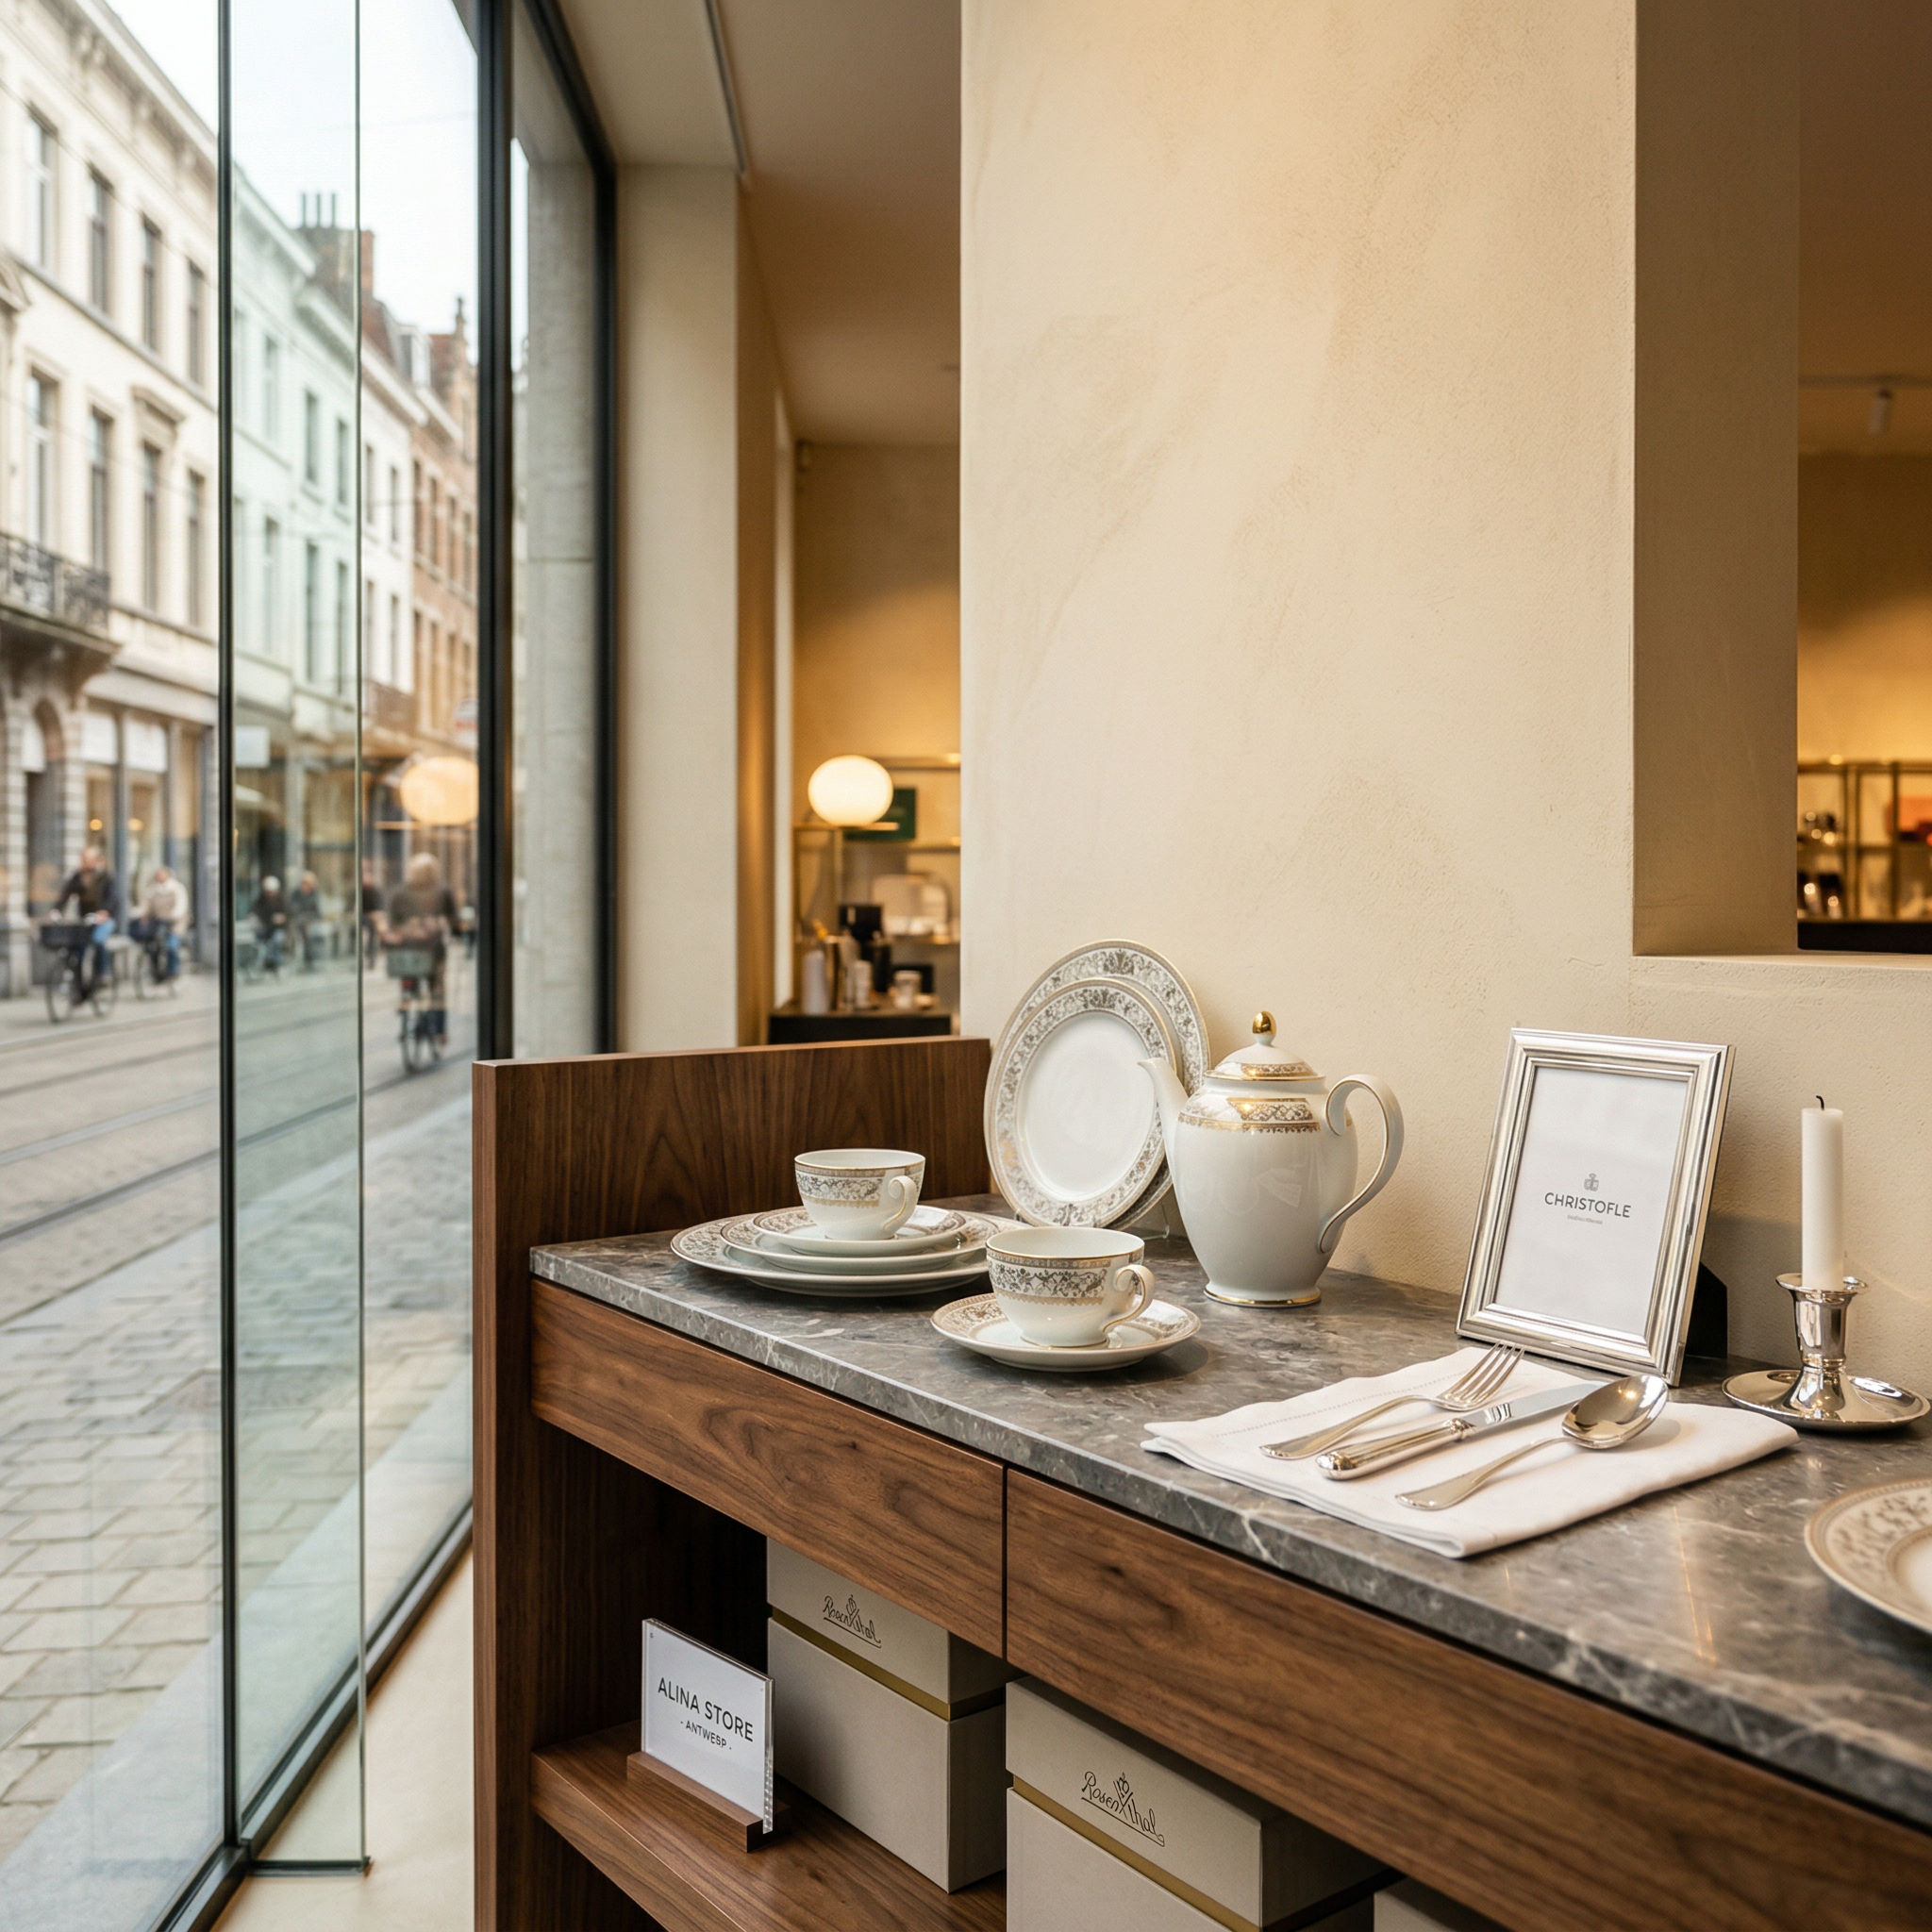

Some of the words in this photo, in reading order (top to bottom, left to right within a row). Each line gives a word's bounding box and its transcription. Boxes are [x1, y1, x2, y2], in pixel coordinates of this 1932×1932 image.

[1544, 1192, 1631, 1218] CHRISTOFLE
[658, 1676, 700, 1714] ALINA
[705, 1701, 754, 1742] STORE
